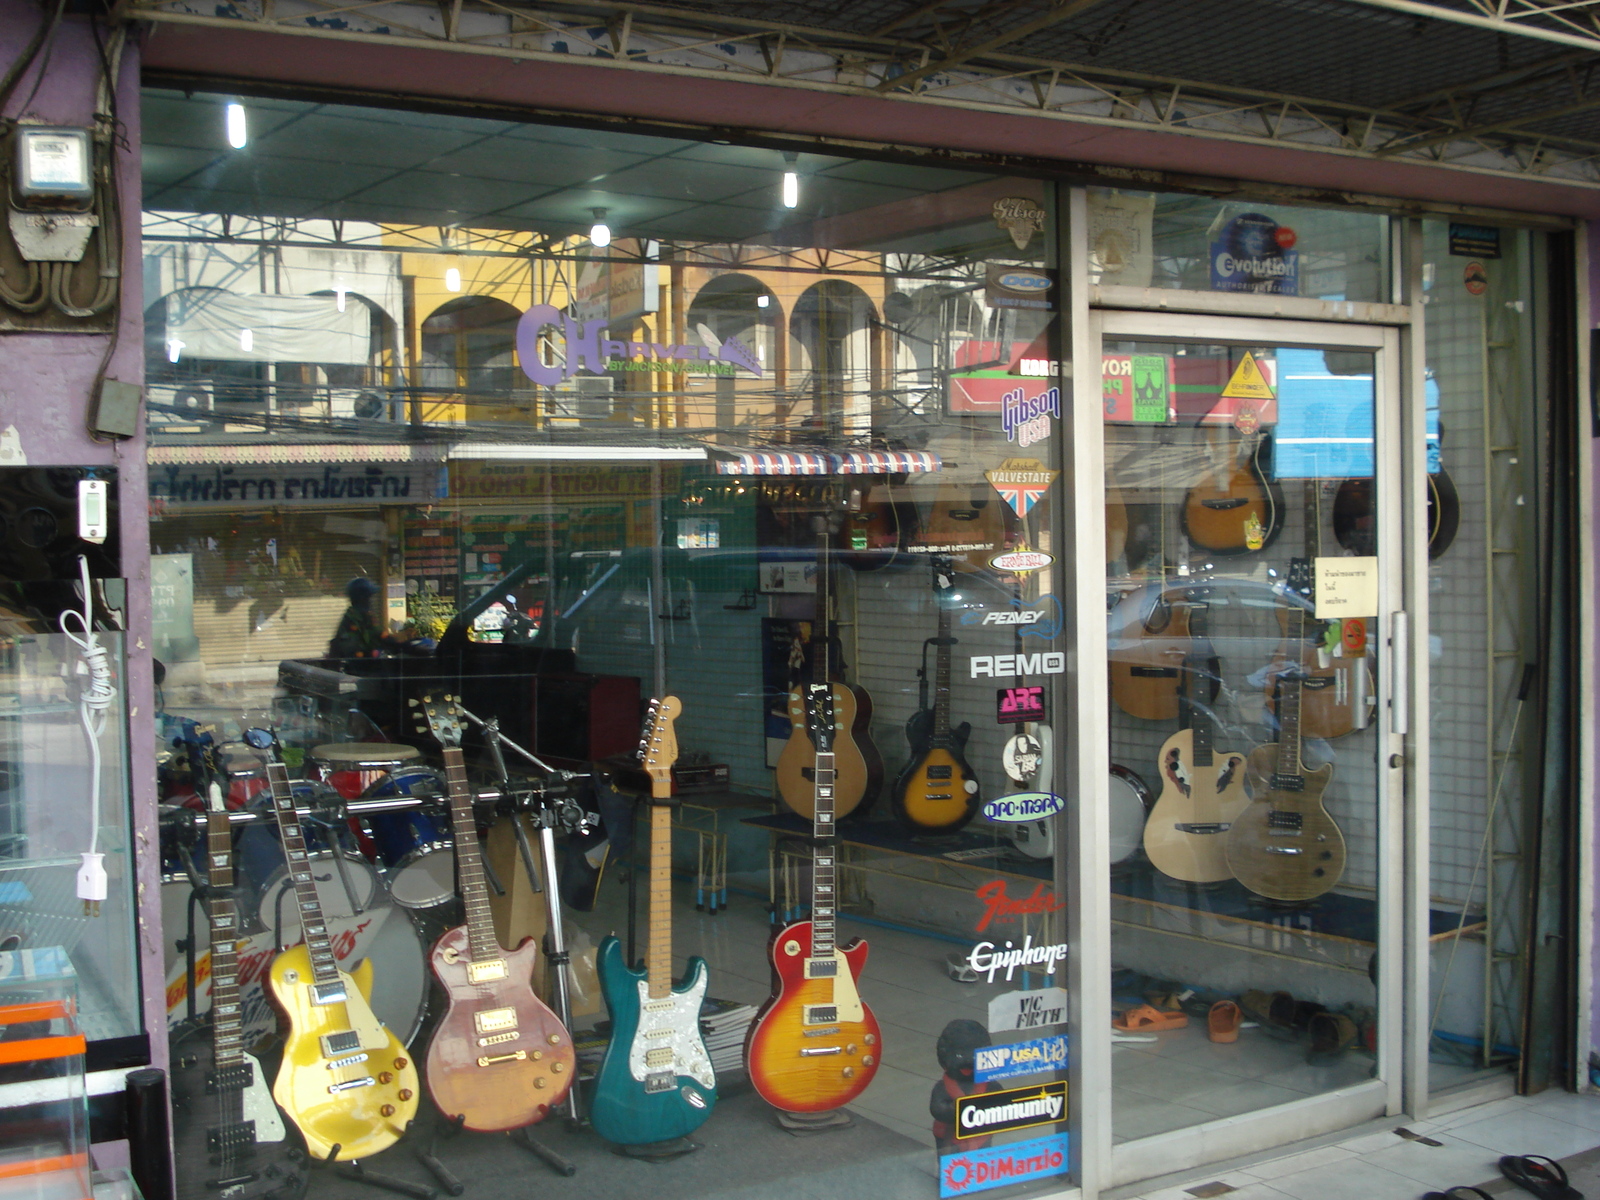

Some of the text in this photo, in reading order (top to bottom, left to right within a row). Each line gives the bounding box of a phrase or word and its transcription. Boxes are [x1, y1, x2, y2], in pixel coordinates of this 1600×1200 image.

[993, 198, 1046, 219] Gibson
[1002, 275, 1052, 288] DOD
[609, 361, 626, 371] BY
[1020, 359, 1059, 376] KORG
[1002, 387, 1060, 442] Gibson
[1019, 415, 1050, 447] USA
[991, 471, 1051, 483] VALVESTATE
[982, 610, 1046, 625] PEAVEY
[970, 652, 1065, 678] REMO
[975, 880, 1067, 932] Fender
[966, 935, 1068, 984] Epiphone
[1019, 996, 1043, 1015] VIC
[1015, 1007, 1061, 1029] FIRTH
[1012, 1047, 1042, 1062] USA
[961, 1096, 1063, 1129] Community
[976, 1148, 1063, 1184] DiMarzio
